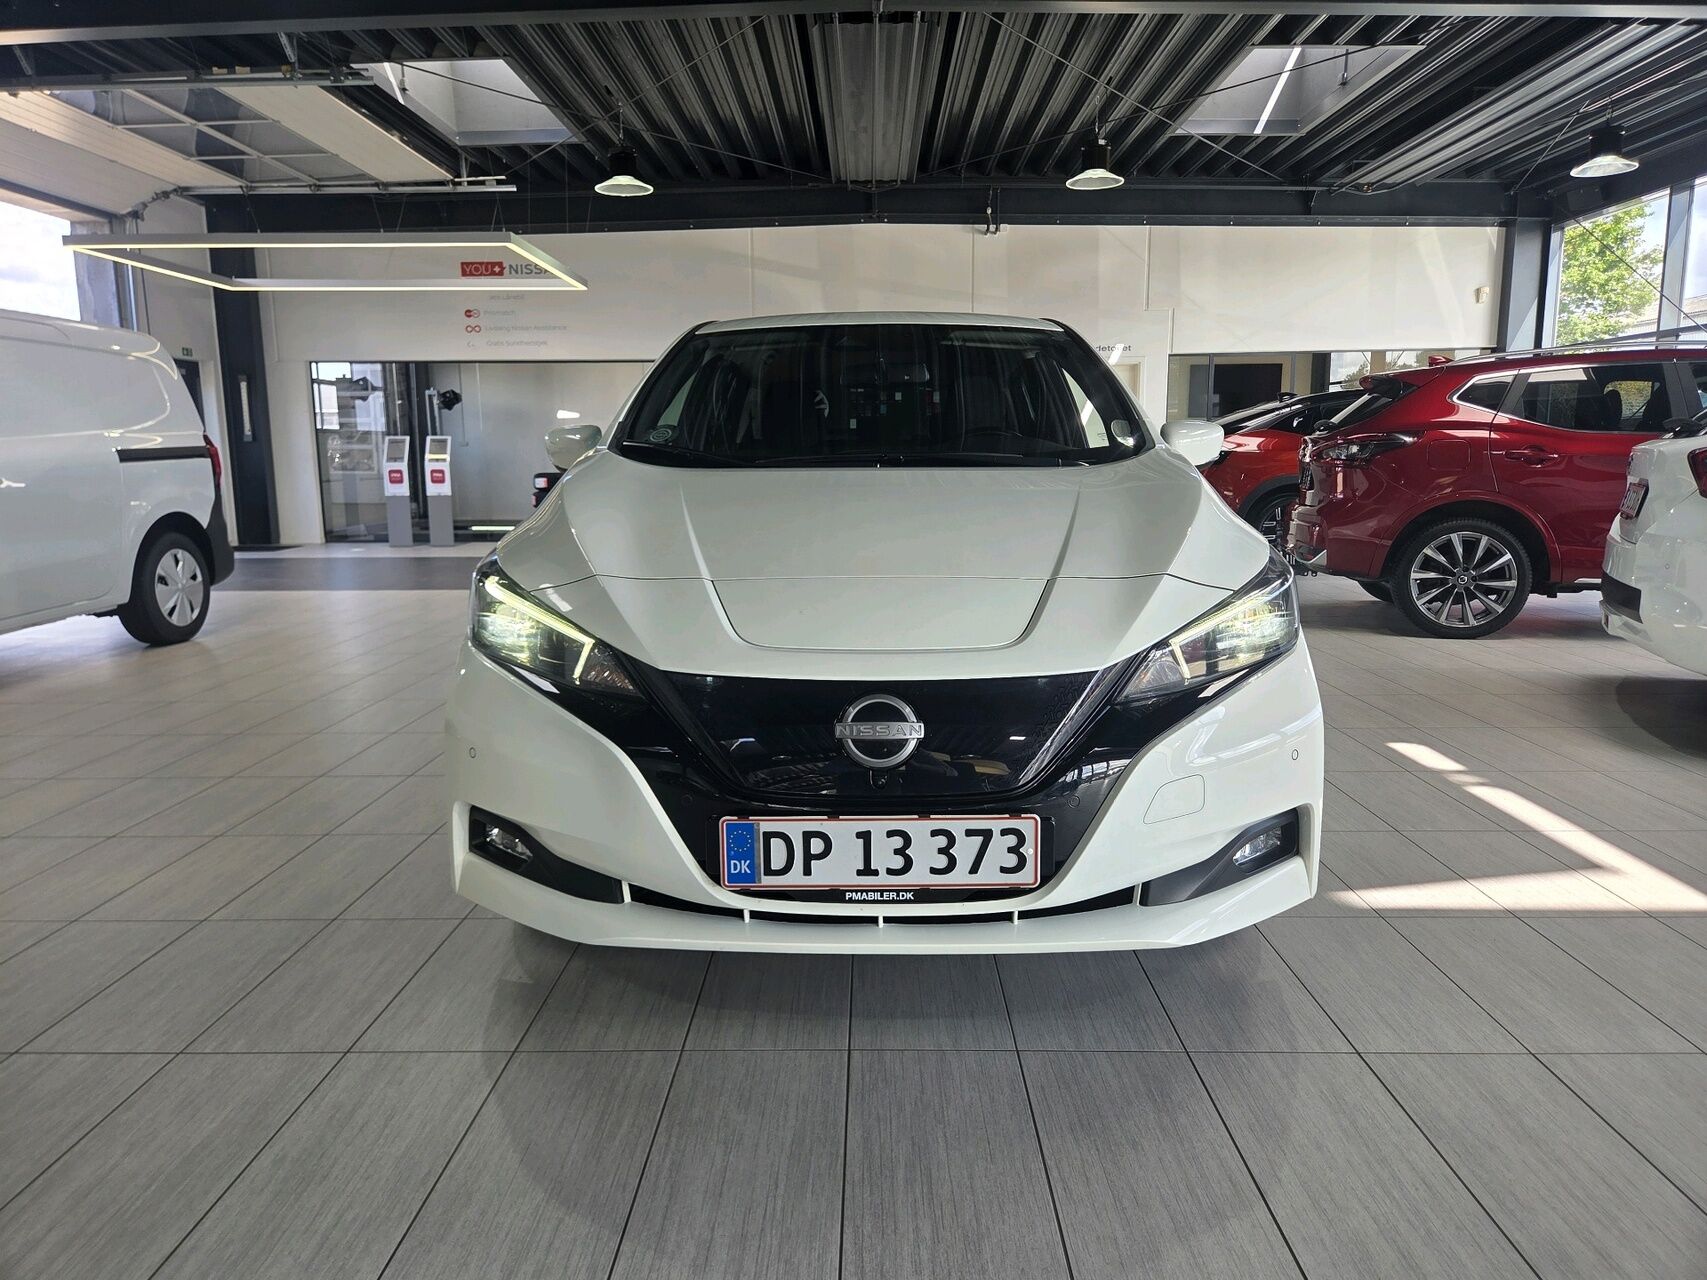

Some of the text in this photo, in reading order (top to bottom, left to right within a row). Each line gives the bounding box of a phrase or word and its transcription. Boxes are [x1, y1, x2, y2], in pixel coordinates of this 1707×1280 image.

[508, 263, 550, 275] NISS
[836, 723, 924, 738] NISSAN
[762, 827, 1028, 877] DP 13 373
[730, 859, 751, 874] DK
[845, 891, 914, 901] PMABILER.DK
